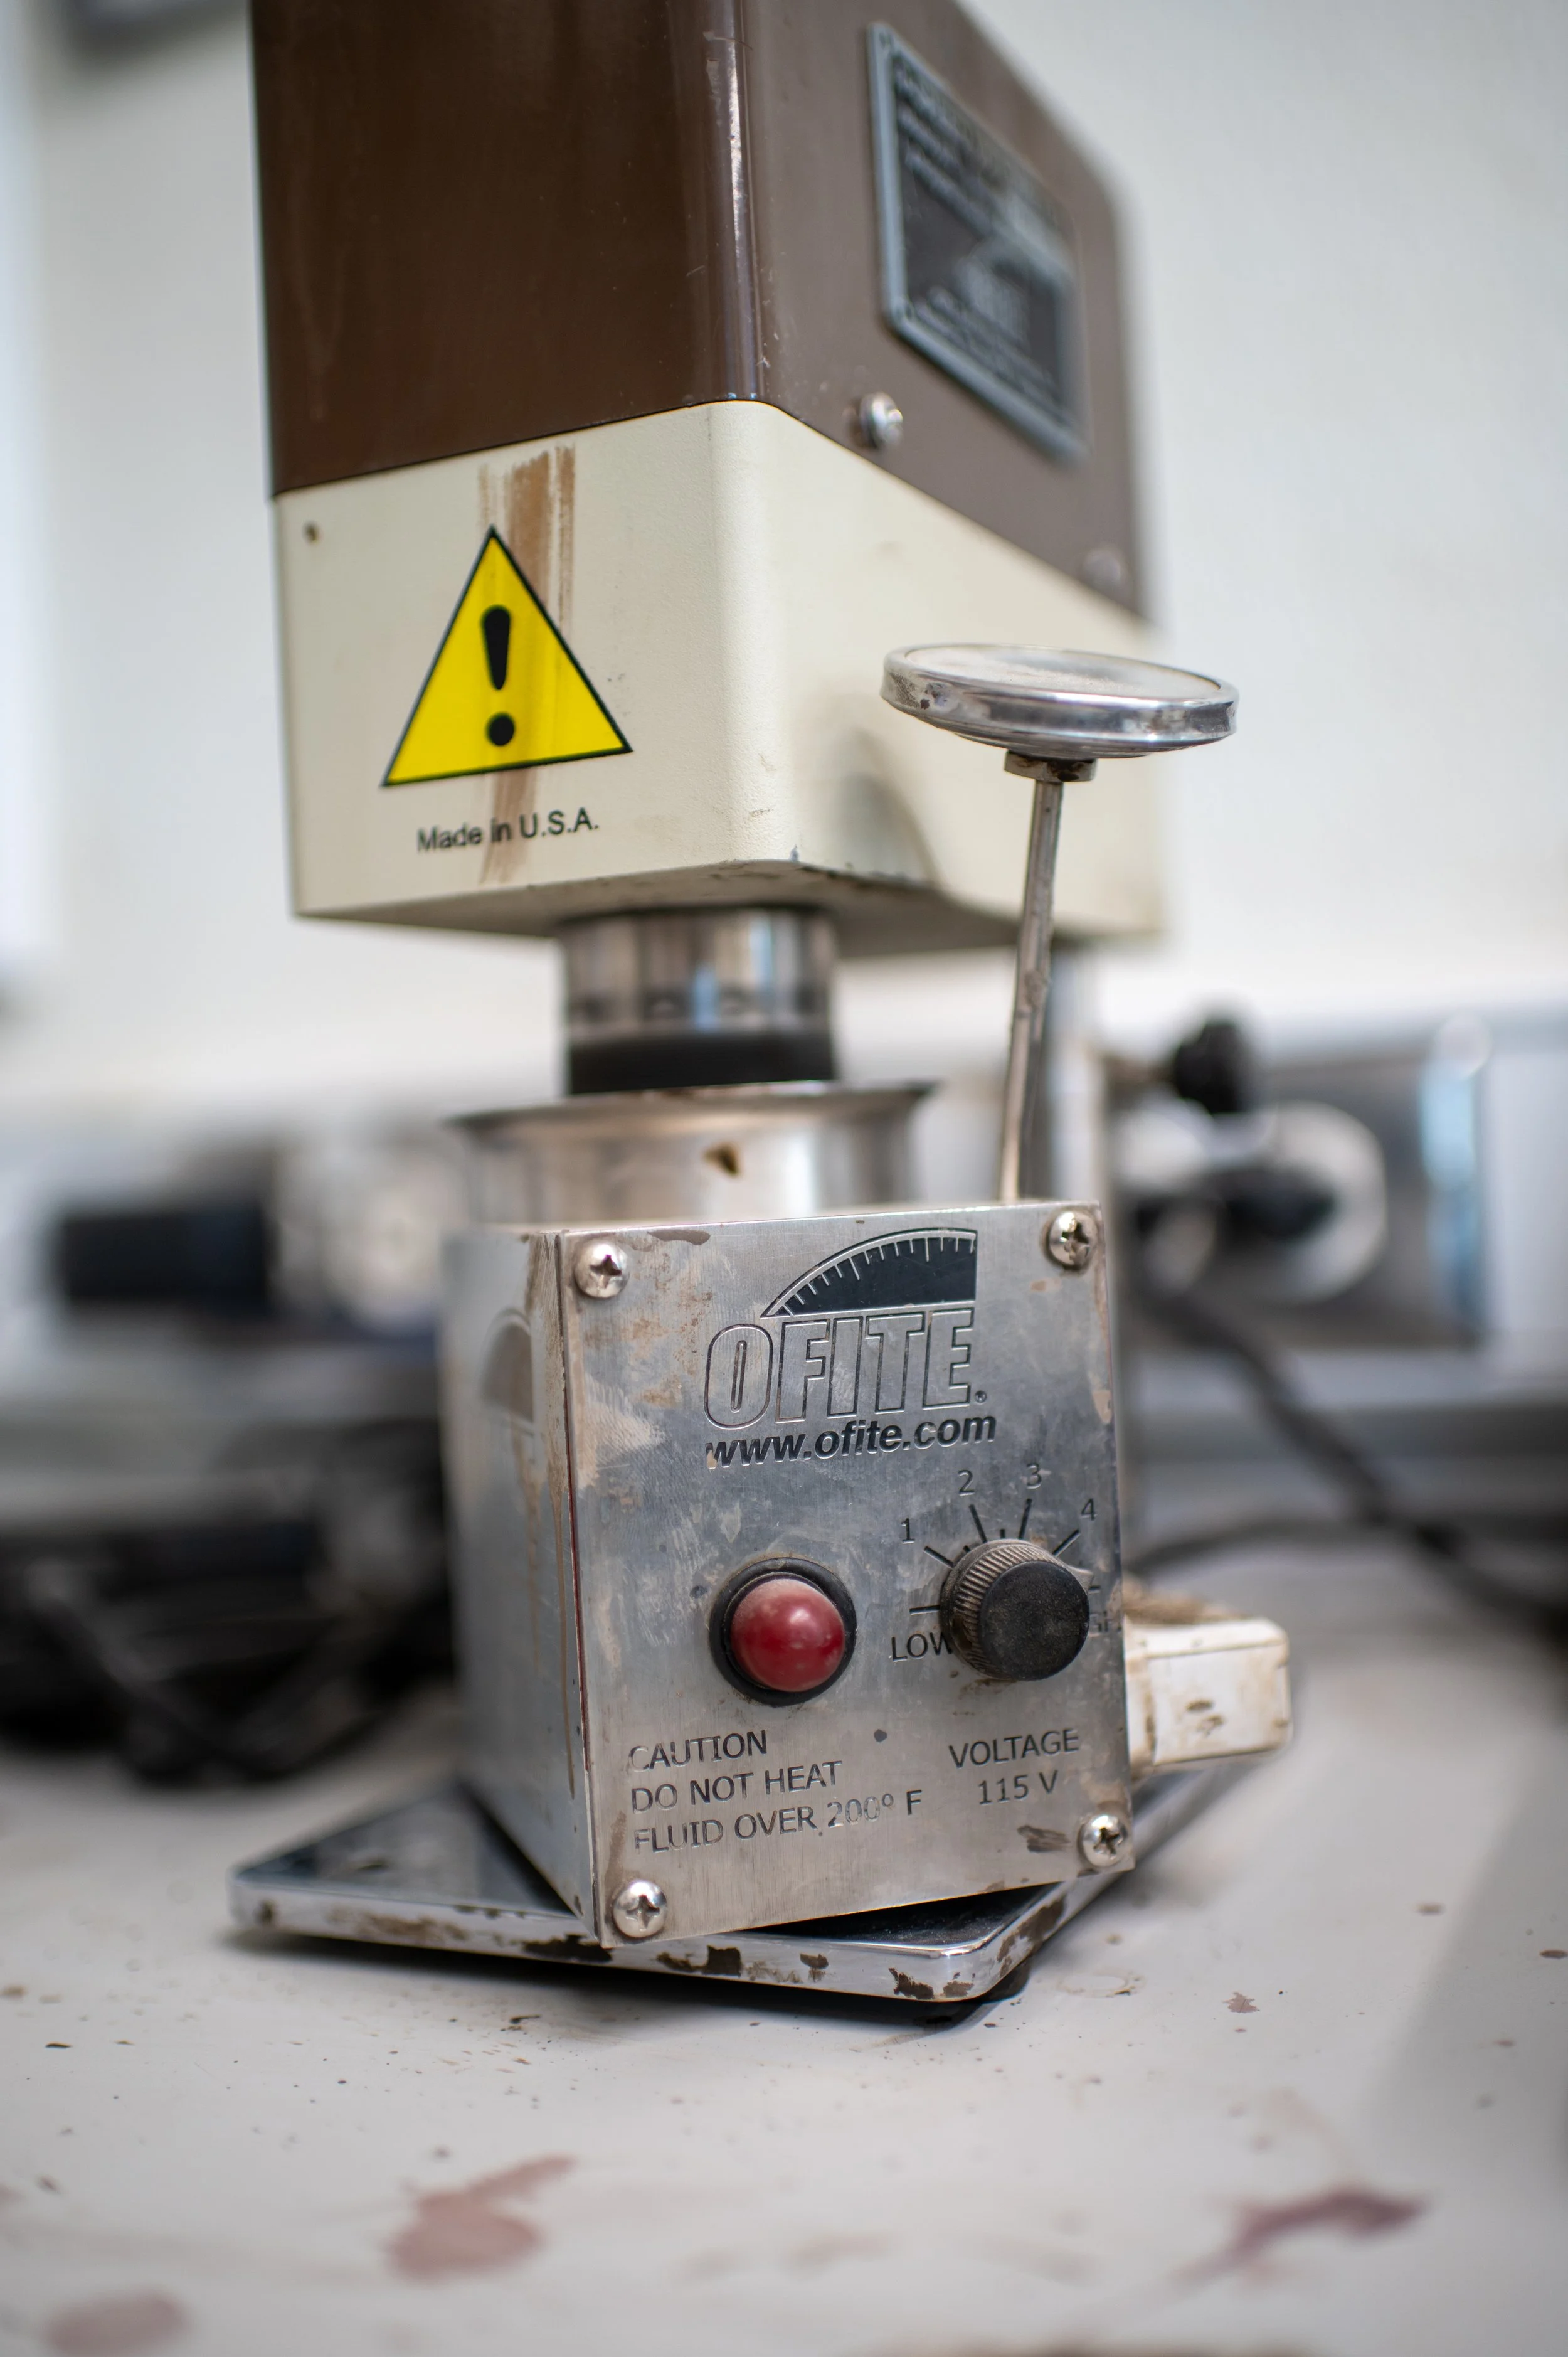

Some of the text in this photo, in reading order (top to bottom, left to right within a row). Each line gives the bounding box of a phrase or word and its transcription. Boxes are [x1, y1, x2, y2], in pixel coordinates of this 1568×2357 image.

[417, 807, 599, 852] Made in U.S.A.
[705, 1415, 997, 1469] www.ofite.com
[958, 1469, 975, 1496] 2
[1025, 1463, 1042, 1489] 3
[1080, 1498, 1097, 1521] 4
[901, 1518, 916, 1545] 1
[891, 1632, 953, 1663] LOW
[628, 1729, 768, 1772] CAUTION
[948, 1727, 1079, 1770] VOLTAGE
[631, 1760, 843, 1814] DO NOT HEAT
[978, 1769, 1059, 1806] 115 V
[633, 1819, 724, 1855] FLUID
[734, 1806, 818, 1841] OVER
[906, 1789, 923, 1816] F
